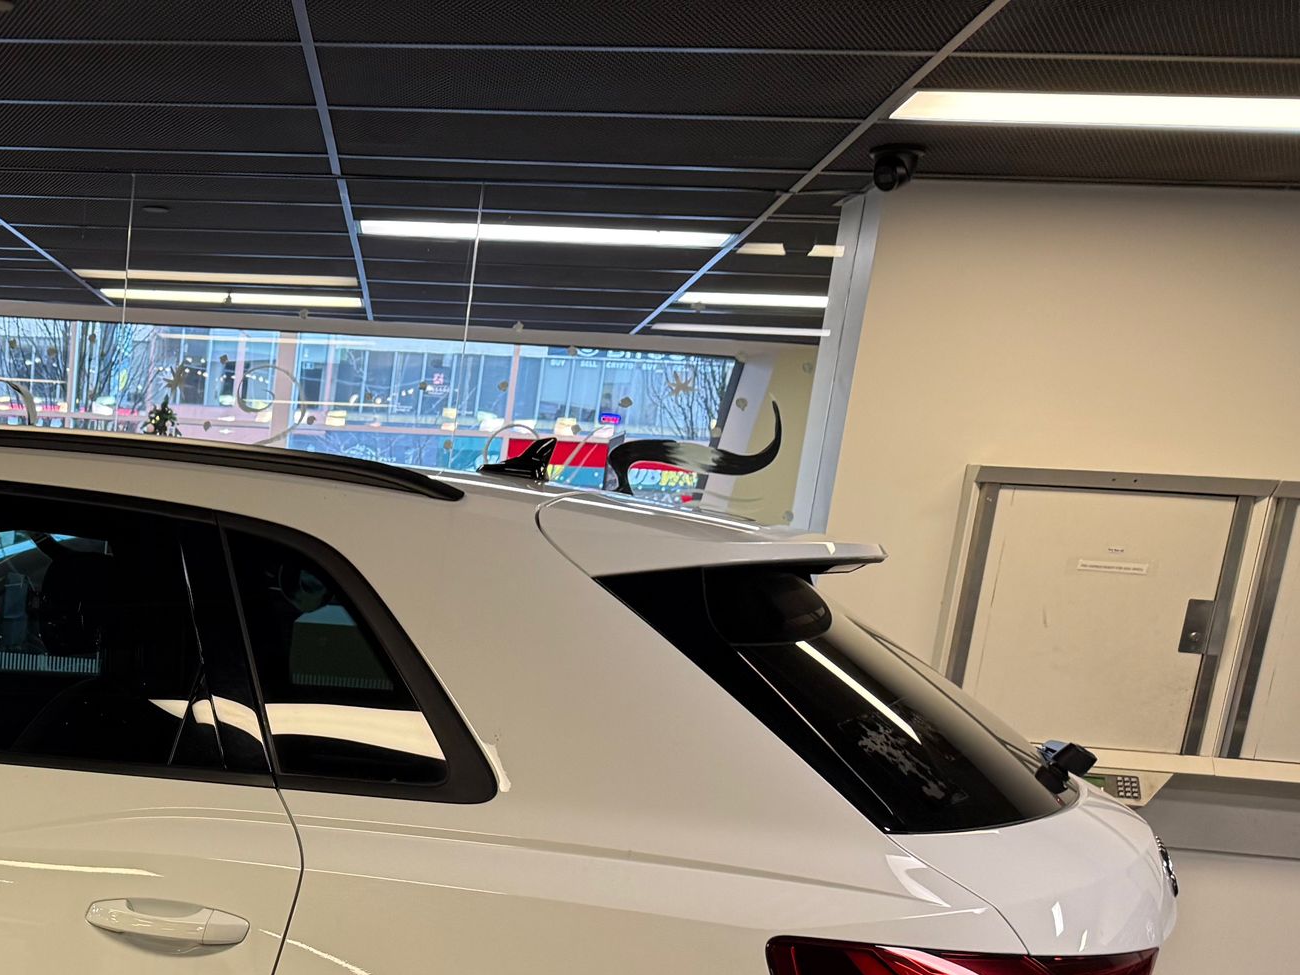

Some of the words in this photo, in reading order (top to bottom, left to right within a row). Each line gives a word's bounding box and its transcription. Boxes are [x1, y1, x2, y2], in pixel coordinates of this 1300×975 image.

[550, 359, 566, 368] BUY
[580, 360, 598, 368] SELL
[606, 361, 634, 370] CRYPTO
[630, 468, 698, 488] UBWA
